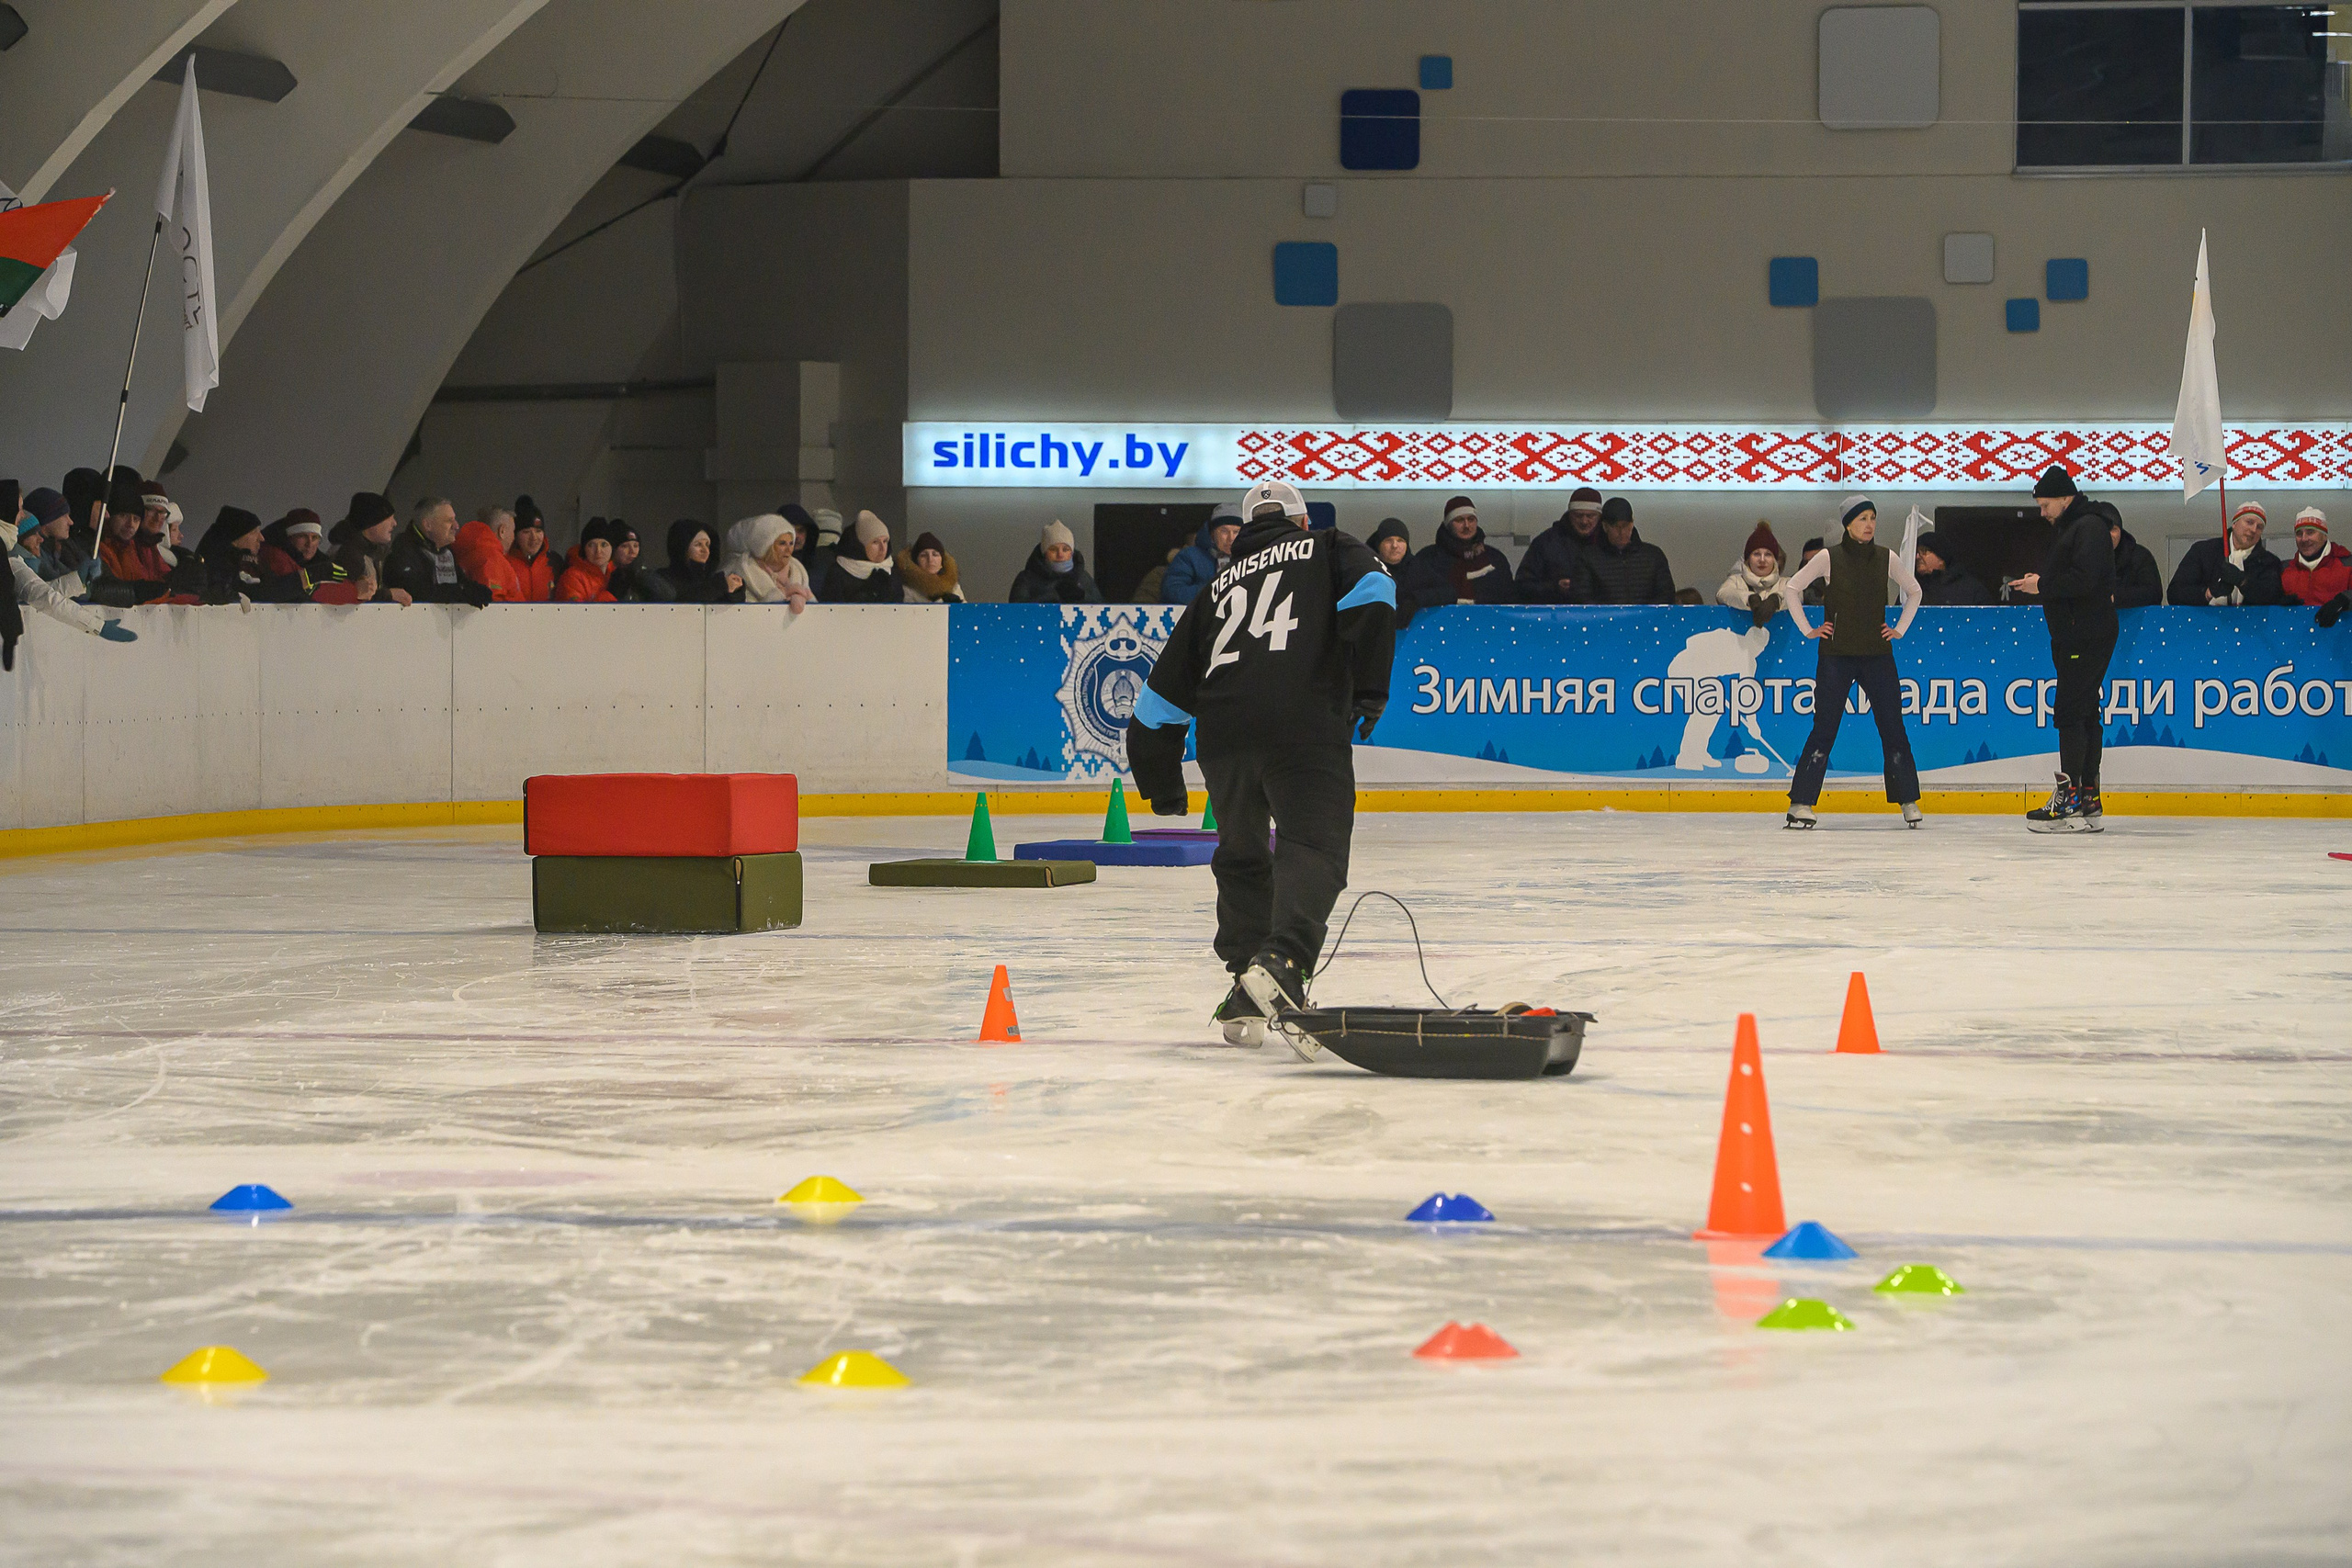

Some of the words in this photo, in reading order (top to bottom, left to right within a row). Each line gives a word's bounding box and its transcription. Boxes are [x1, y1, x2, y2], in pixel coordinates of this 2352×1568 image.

[933, 433, 1189, 478] silichy.by
[1211, 537, 1315, 604] DENISENKO
[1205, 570, 1299, 679] 24
[1411, 664, 1616, 715] Зимняя
[1633, 677, 1988, 727] спартаада
[2004, 678, 2175, 728] срди
[2193, 663, 2352, 728] работ
